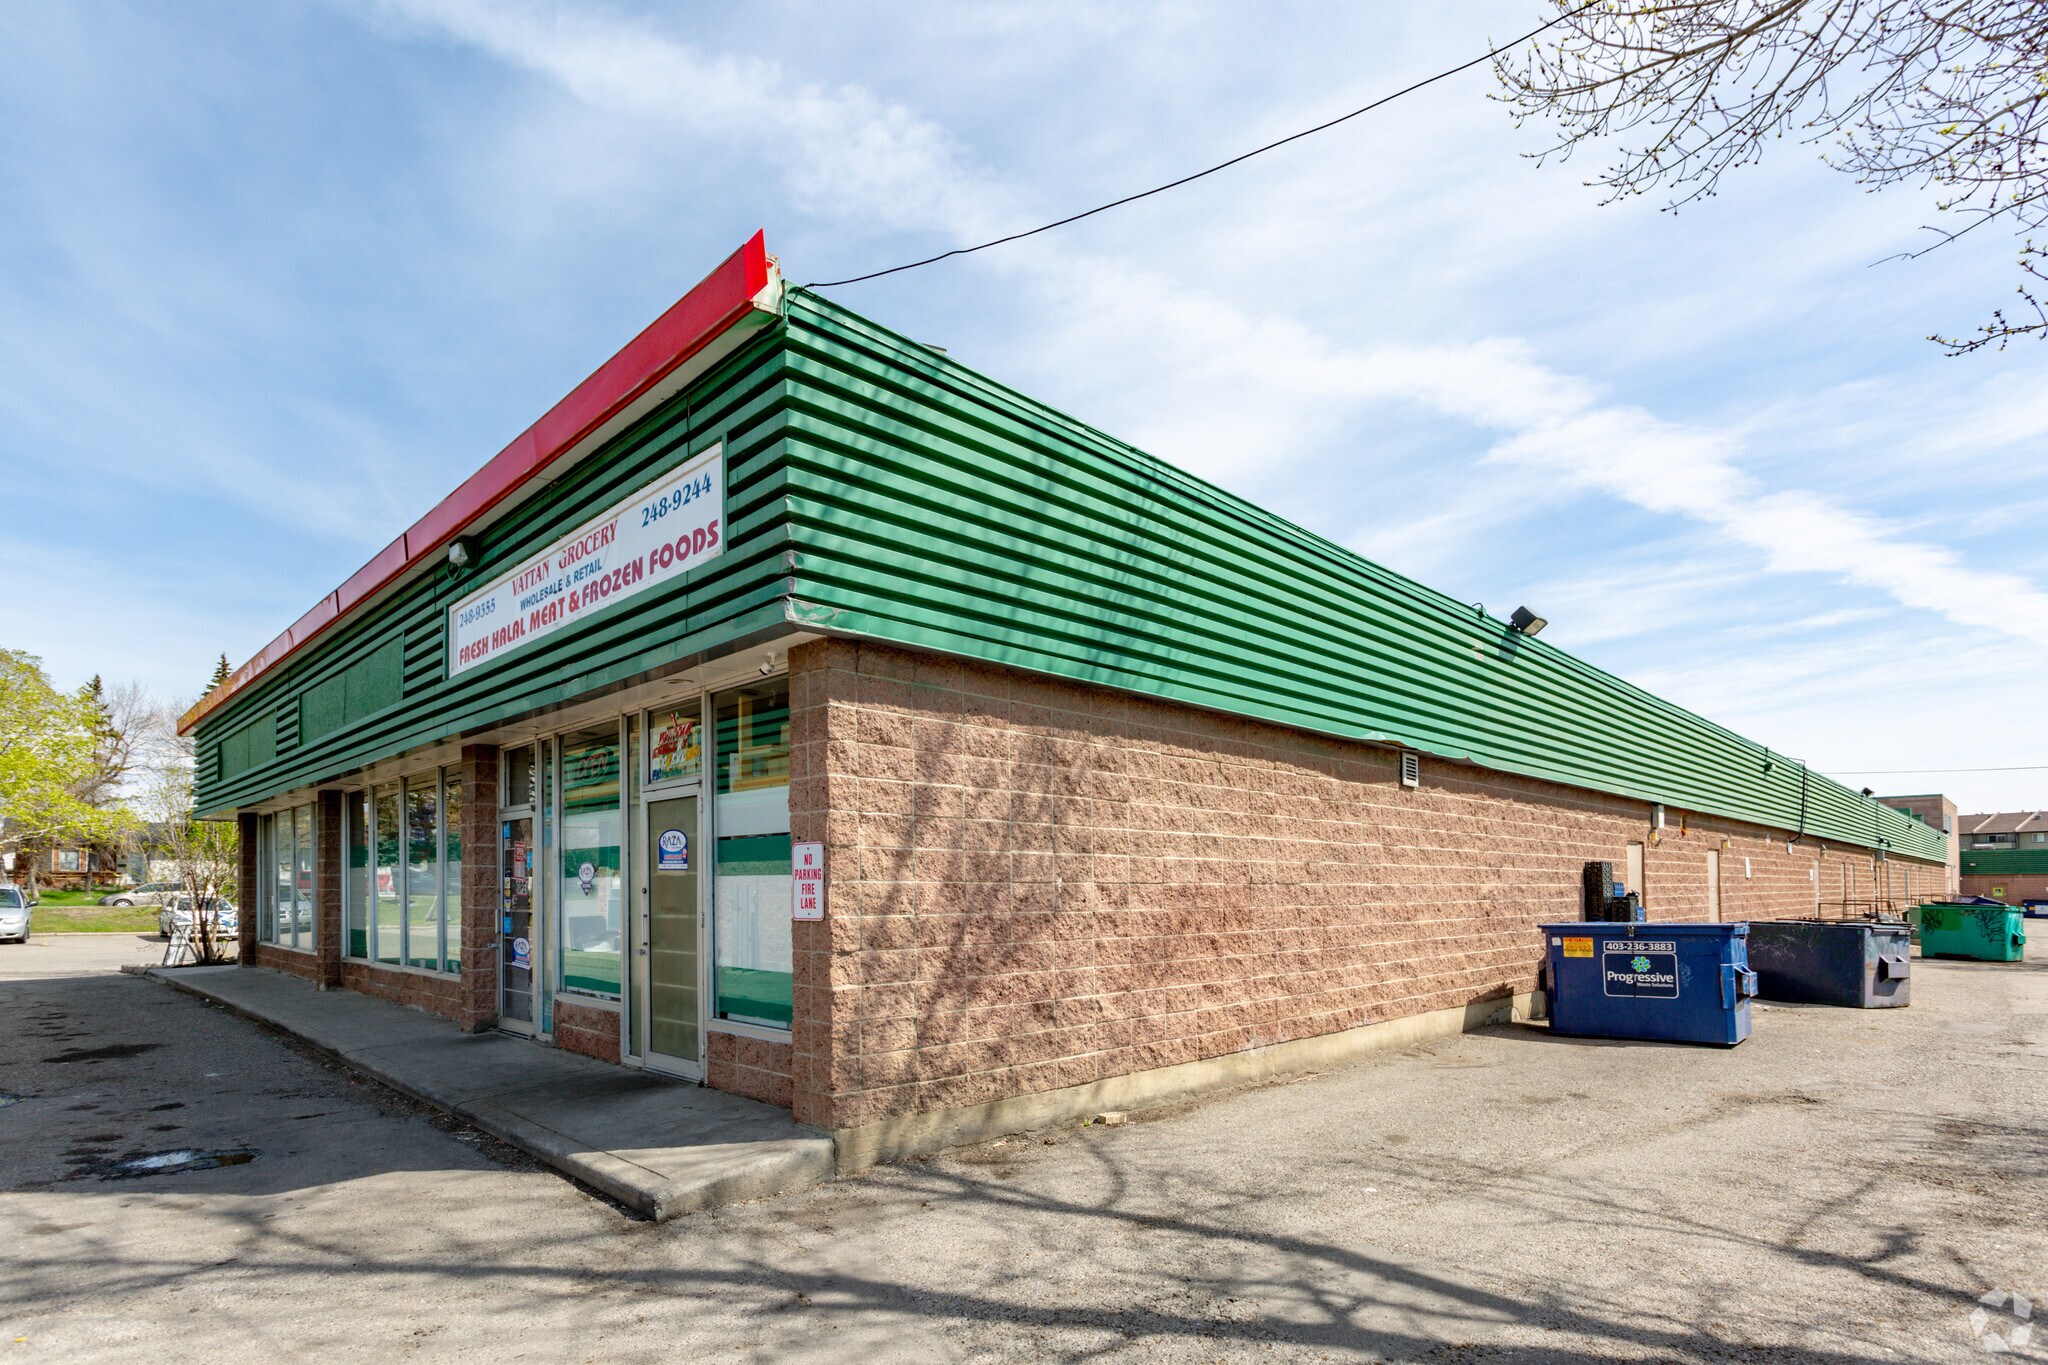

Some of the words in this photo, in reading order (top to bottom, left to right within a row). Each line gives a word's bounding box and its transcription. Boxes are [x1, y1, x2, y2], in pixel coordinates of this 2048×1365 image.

[642, 472, 712, 528] 248-9244
[512, 560, 550, 596] VATTAN
[559, 520, 618, 569] GROCERY
[520, 578, 563, 612] WHOLESALE
[566, 574, 572, 587] &
[573, 558, 603, 583] RETAIL
[459, 635, 489, 666] FRESH
[492, 617, 526, 650] HALAL
[529, 596, 566, 633] MEAT
[568, 589, 580, 613] &
[582, 556, 643, 608] FROZEN
[649, 519, 719, 575] FOODS
[459, 597, 496, 628] 248-9355
[577, 751, 609, 778] OPEN
[662, 835, 682, 848] RAZA
[803, 853, 813, 865] NO
[794, 868, 822, 880] PARKING
[801, 883, 815, 895] FIRE
[800, 897, 817, 909] LANE
[1606, 942, 1672, 951] 403-236-3883
[1606, 971, 1674, 984] Progressive
